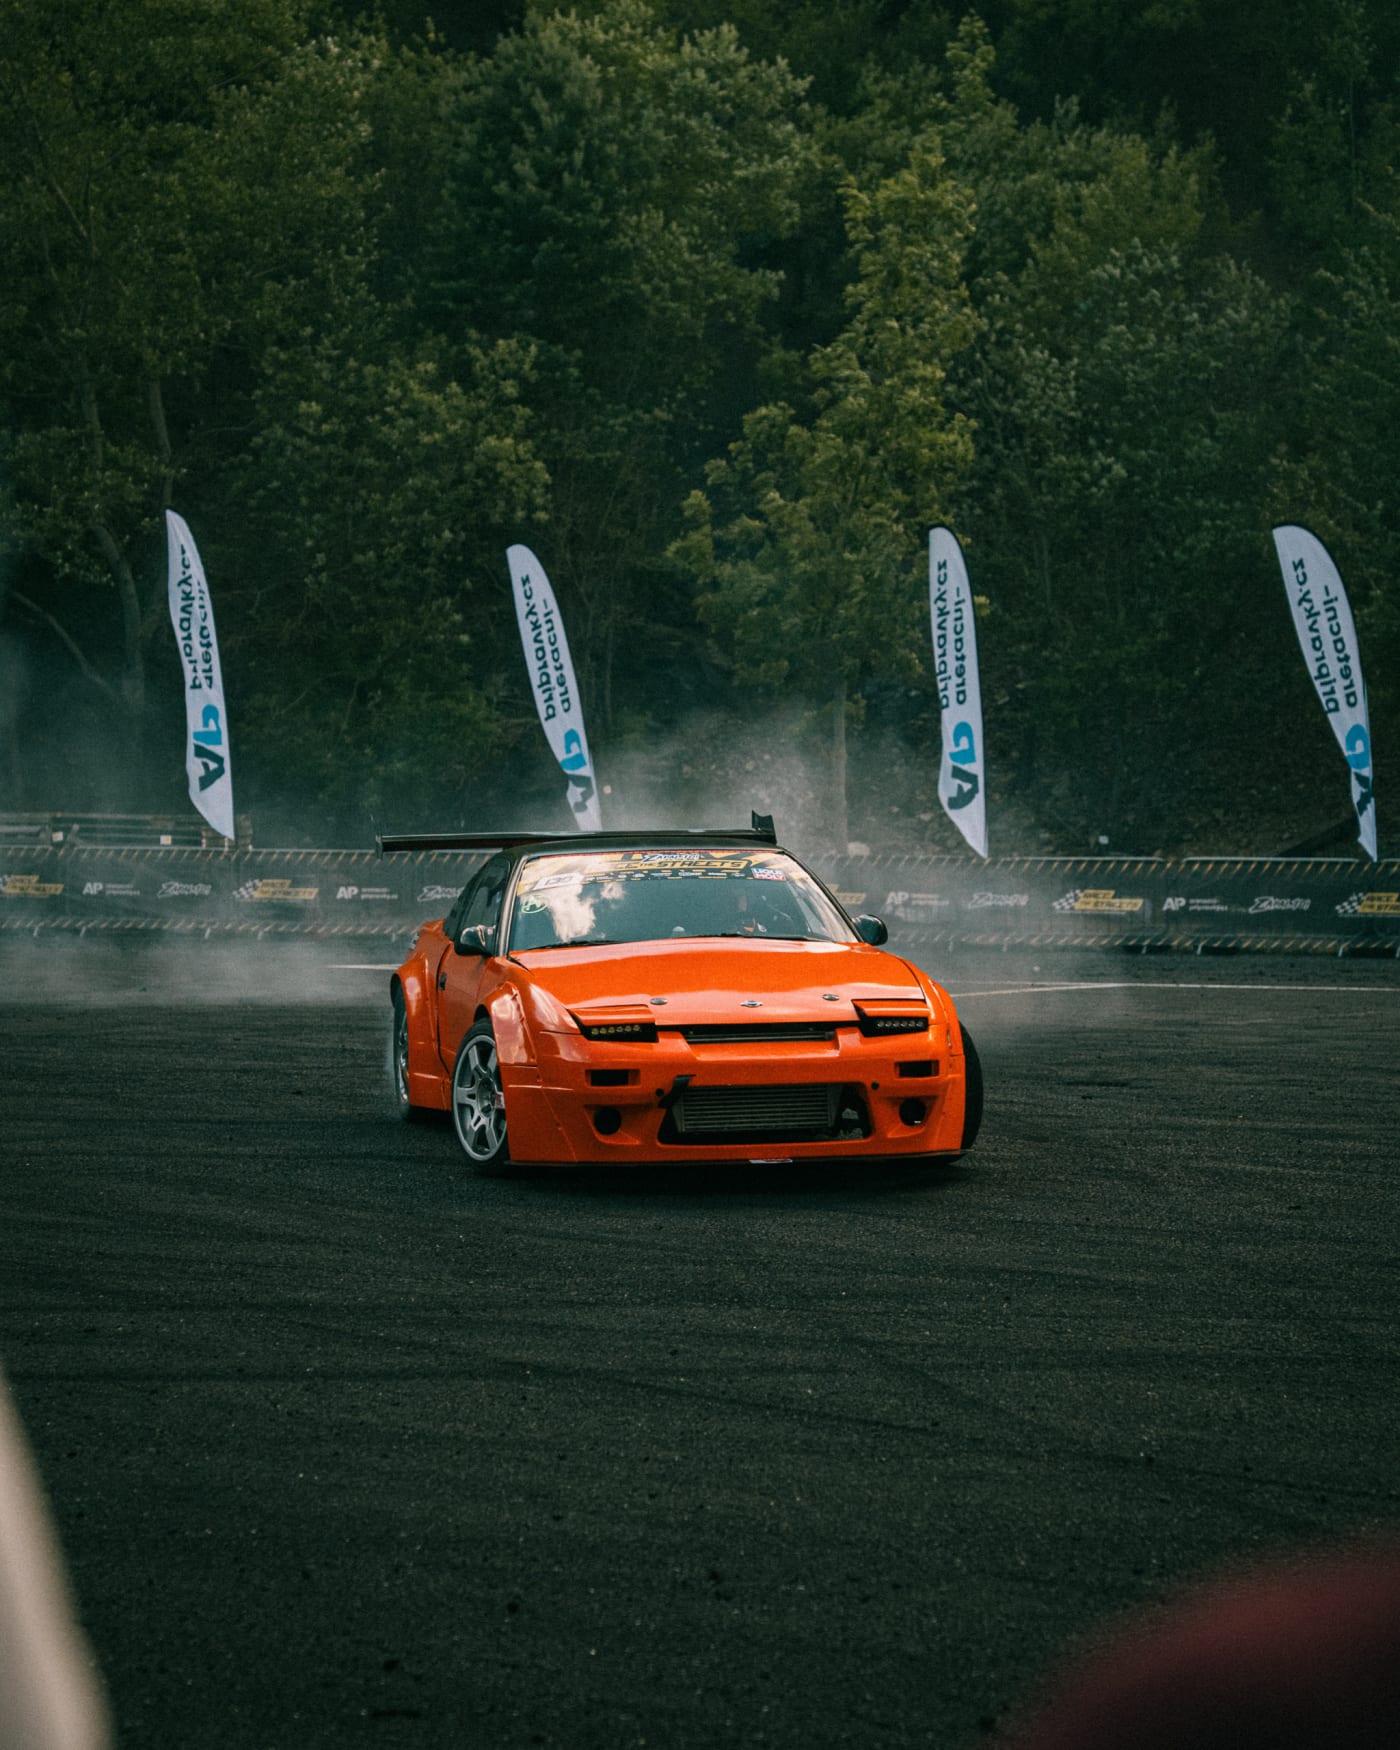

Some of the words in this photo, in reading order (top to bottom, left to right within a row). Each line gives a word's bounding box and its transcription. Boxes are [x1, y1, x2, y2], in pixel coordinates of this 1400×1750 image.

[655, 860, 742, 869] STREETS
[82, 882, 103, 895] AP
[336, 886, 359, 899] AP
[886, 891, 909, 905] AP
[1162, 897, 1186, 911] AP
